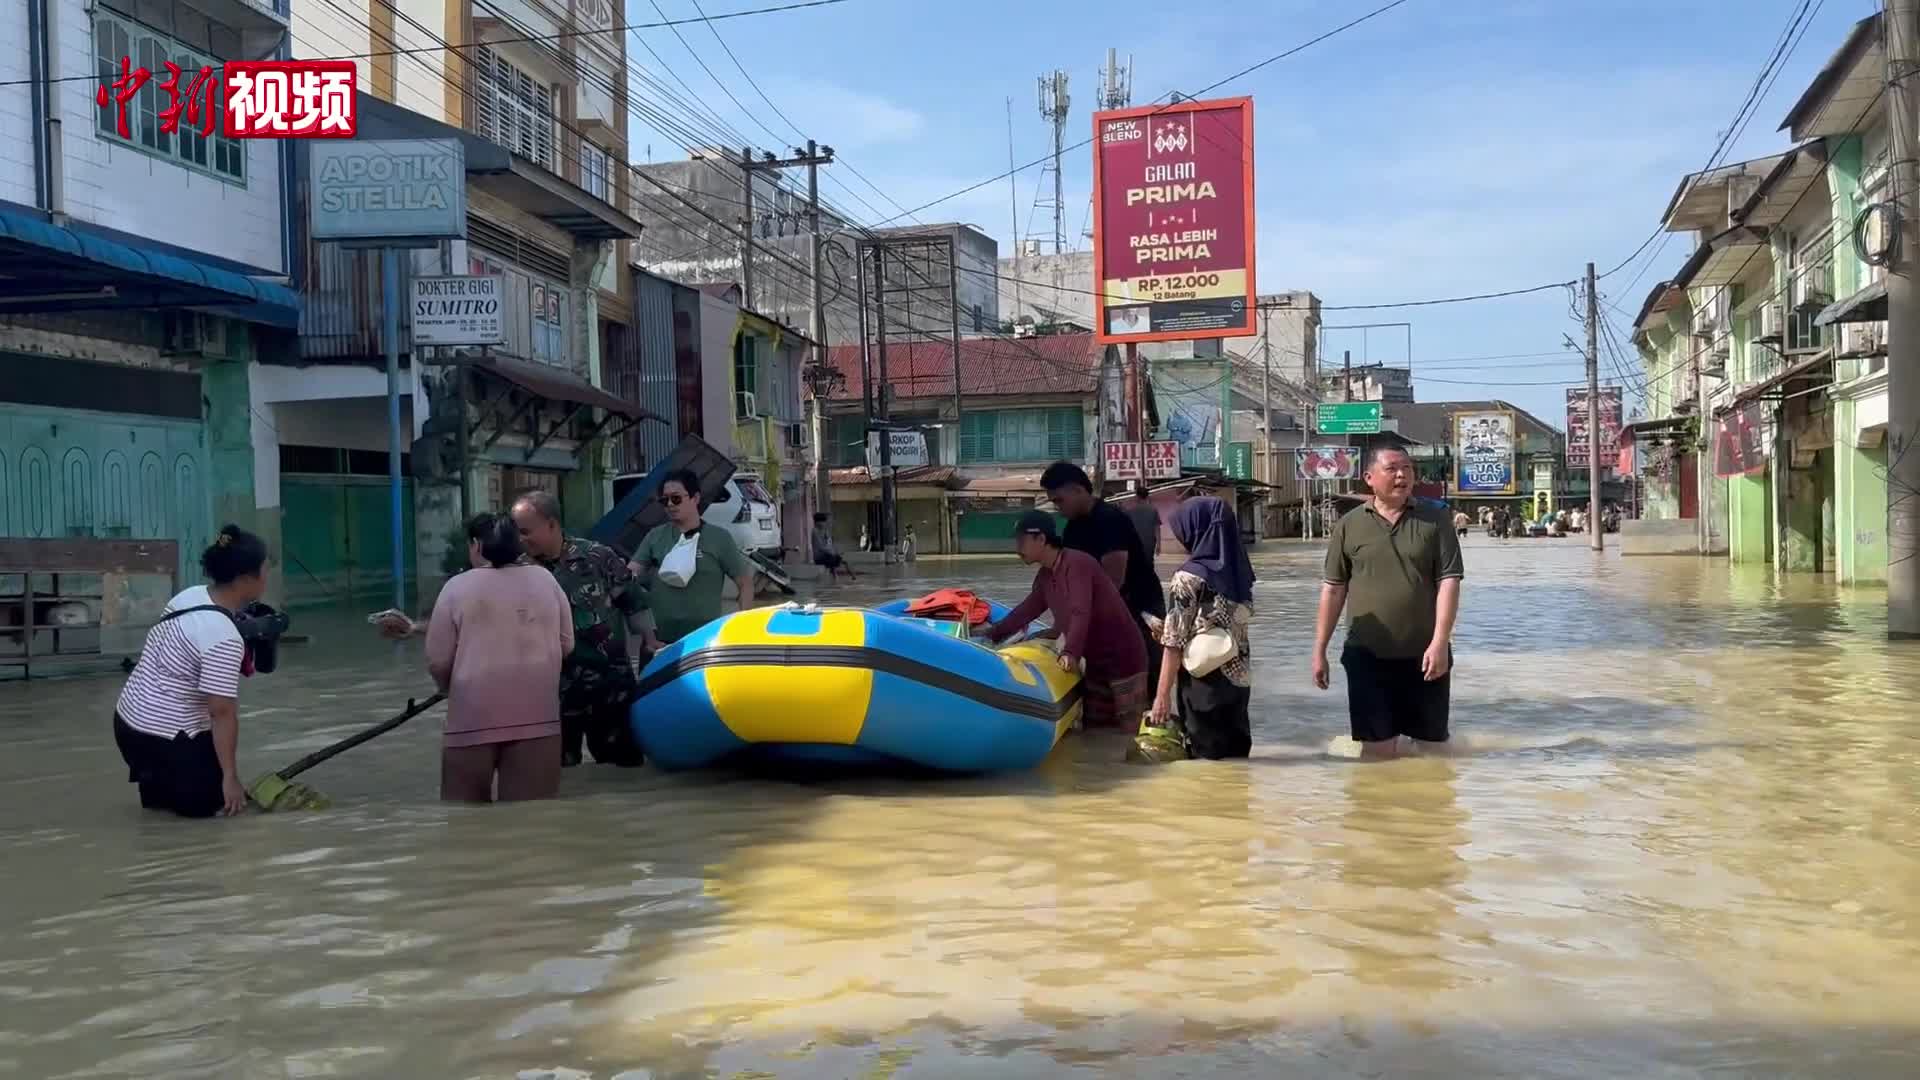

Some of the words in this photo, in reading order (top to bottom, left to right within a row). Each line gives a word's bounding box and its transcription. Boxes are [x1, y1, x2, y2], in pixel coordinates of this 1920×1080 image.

[1106, 121, 1137, 132] NEW
[1102, 130, 1142, 143] BLEND
[320, 154, 449, 184] APOTIK
[1145, 162, 1195, 183] GALAN
[321, 183, 448, 212] STELLA
[1127, 181, 1216, 206] PRIMA
[1130, 233, 1170, 247] RASA
[1174, 229, 1217, 243] LEBIH
[1136, 244, 1211, 264] PRIMA
[417, 280, 465, 296] DOKTER
[468, 279, 494, 294] GIGI
[1138, 278, 1162, 292] RP.
[1165, 274, 1219, 289] 12.000
[1153, 292, 1163, 300] 12
[1164, 291, 1196, 300] Batang
[416, 299, 498, 316] SUMITRO
[875, 446, 919, 456] WNOGIRI
[1106, 442, 1176, 460] RILEX
